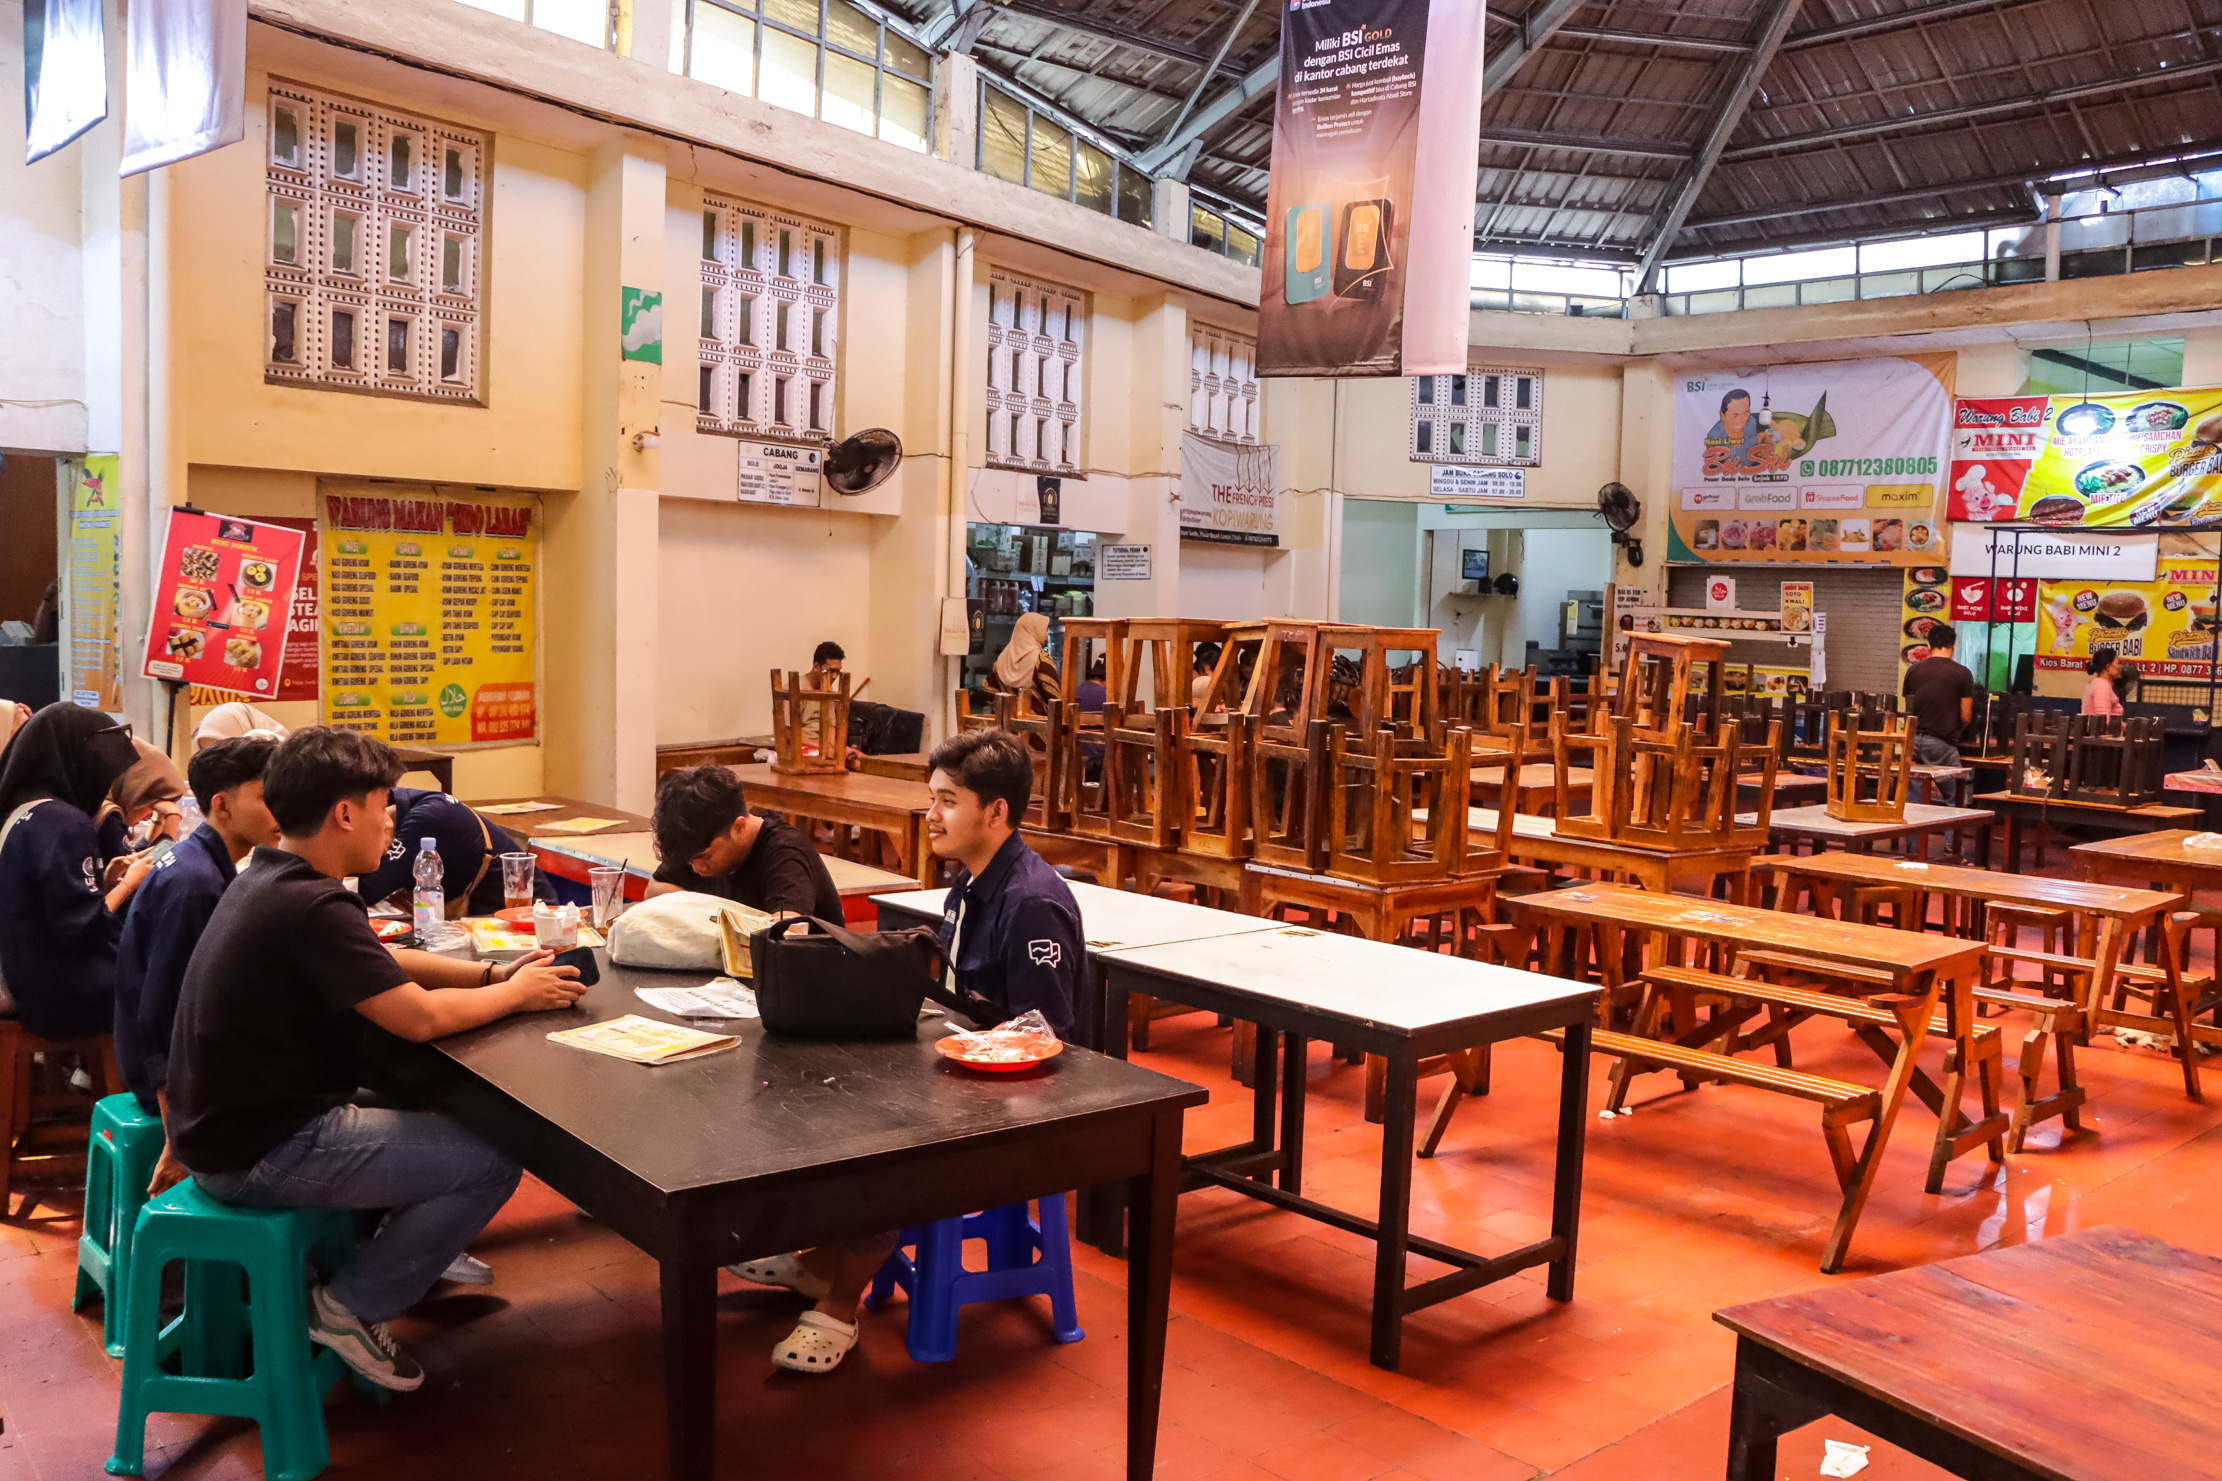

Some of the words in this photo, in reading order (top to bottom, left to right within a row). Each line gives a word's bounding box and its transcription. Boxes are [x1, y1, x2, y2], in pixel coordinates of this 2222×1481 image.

[1316, 37, 1340, 52] Miliki
[1342, 30, 1363, 47] BSI
[1364, 28, 1392, 42] GOLD
[1304, 54, 1336, 67] dengan
[1338, 48, 1352, 62] BSI
[1354, 45, 1374, 59] Cicil
[1376, 42, 1400, 55] Emas
[1295, 71, 1302, 83] di
[1304, 69, 1332, 81] kantor
[1335, 65, 1367, 74] cabang
[1368, 54, 1409, 72] terdekat
[1687, 380, 1705, 392] BSI
[1959, 408, 2005, 426] Warung
[2009, 406, 2040, 423] Babi
[2043, 407, 2053, 421] 2
[1974, 434, 2036, 446] MINI
[2053, 437, 2066, 445] MIE
[2144, 431, 2181, 441] SAMCHAN
[764, 447, 798, 459] CABANG
[1702, 446, 1742, 475] Bu
[1742, 444, 1792, 475] Sri
[1819, 457, 1937, 476] 087712380805
[2170, 461, 2206, 477] BURGER
[1212, 484, 1232, 504] THE
[1232, 493, 1257, 506] FRENCH
[1259, 495, 1274, 508] PRESS
[1745, 493, 1791, 504] GrabFood
[1816, 493, 1858, 502] ShopeeFood
[1882, 492, 1918, 501] maxim
[2090, 494, 2105, 504] MIE
[326, 495, 391, 533] WARUNG
[392, 500, 444, 535] MAKAN
[1212, 507, 1273, 531] KOPIWARUNG
[211, 538, 229, 548] MENU
[1985, 545, 2042, 555] WARUNG
[2046, 546, 2075, 555] BABI
[2079, 546, 2109, 555] MINI
[2113, 546, 2120, 556] 2
[2077, 592, 2092, 601] NEW
[2166, 593, 2181, 603] NEW
[2077, 600, 2096, 610] MENU
[2167, 601, 2185, 611] MENU
[2088, 627, 2129, 644] Pizza
[2123, 638, 2142, 656] BABI
[2039, 657, 2058, 667] Kios
[2060, 659, 2083, 669] Barat
[2151, 664, 2156, 672] 2
[2163, 664, 2178, 673] HP.
[2181, 665, 2202, 674] 0877
[441, 687, 465, 705] حلال
